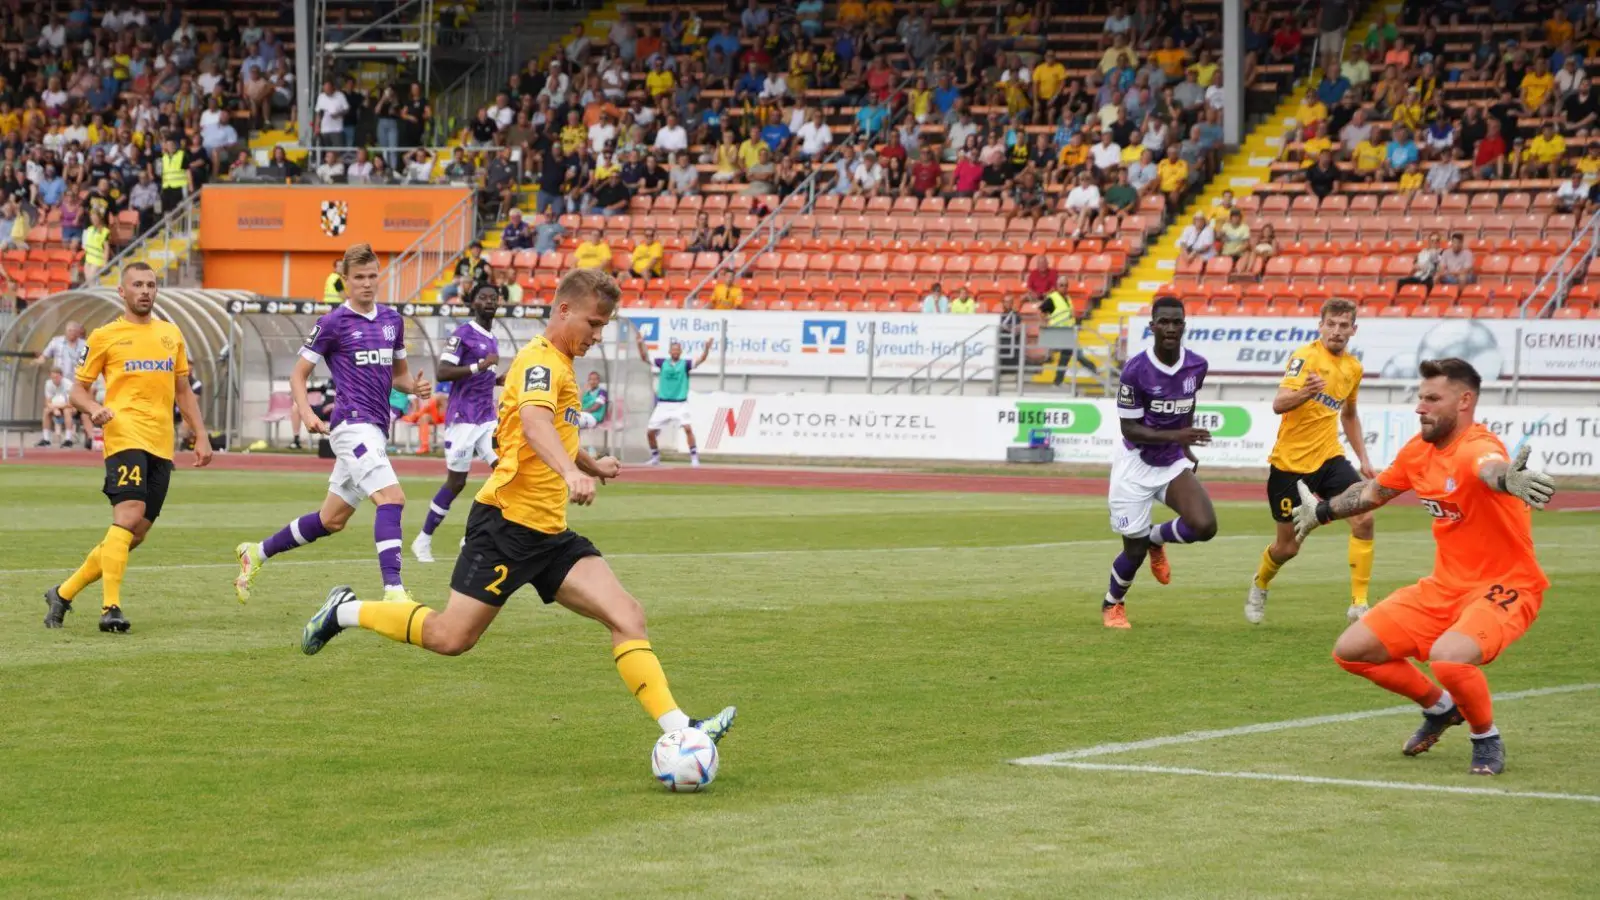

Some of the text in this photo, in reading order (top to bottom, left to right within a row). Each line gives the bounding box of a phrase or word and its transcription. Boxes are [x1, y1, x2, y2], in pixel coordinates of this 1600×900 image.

[669, 318, 689, 331] VR
[882, 321, 919, 335] Bank
[771, 339, 791, 352] eG
[1524, 332, 1600, 349] GEMEIN
[124, 357, 175, 371] maxit
[759, 410, 936, 429] MOTOR-NÜTZEL
[998, 411, 1070, 425] PAUSCHER
[1522, 418, 1567, 436] und
[1541, 450, 1593, 466] vom
[117, 465, 142, 487] 24
[1280, 498, 1293, 517] 9
[484, 564, 509, 596] 2
[1484, 584, 1519, 613] 22
